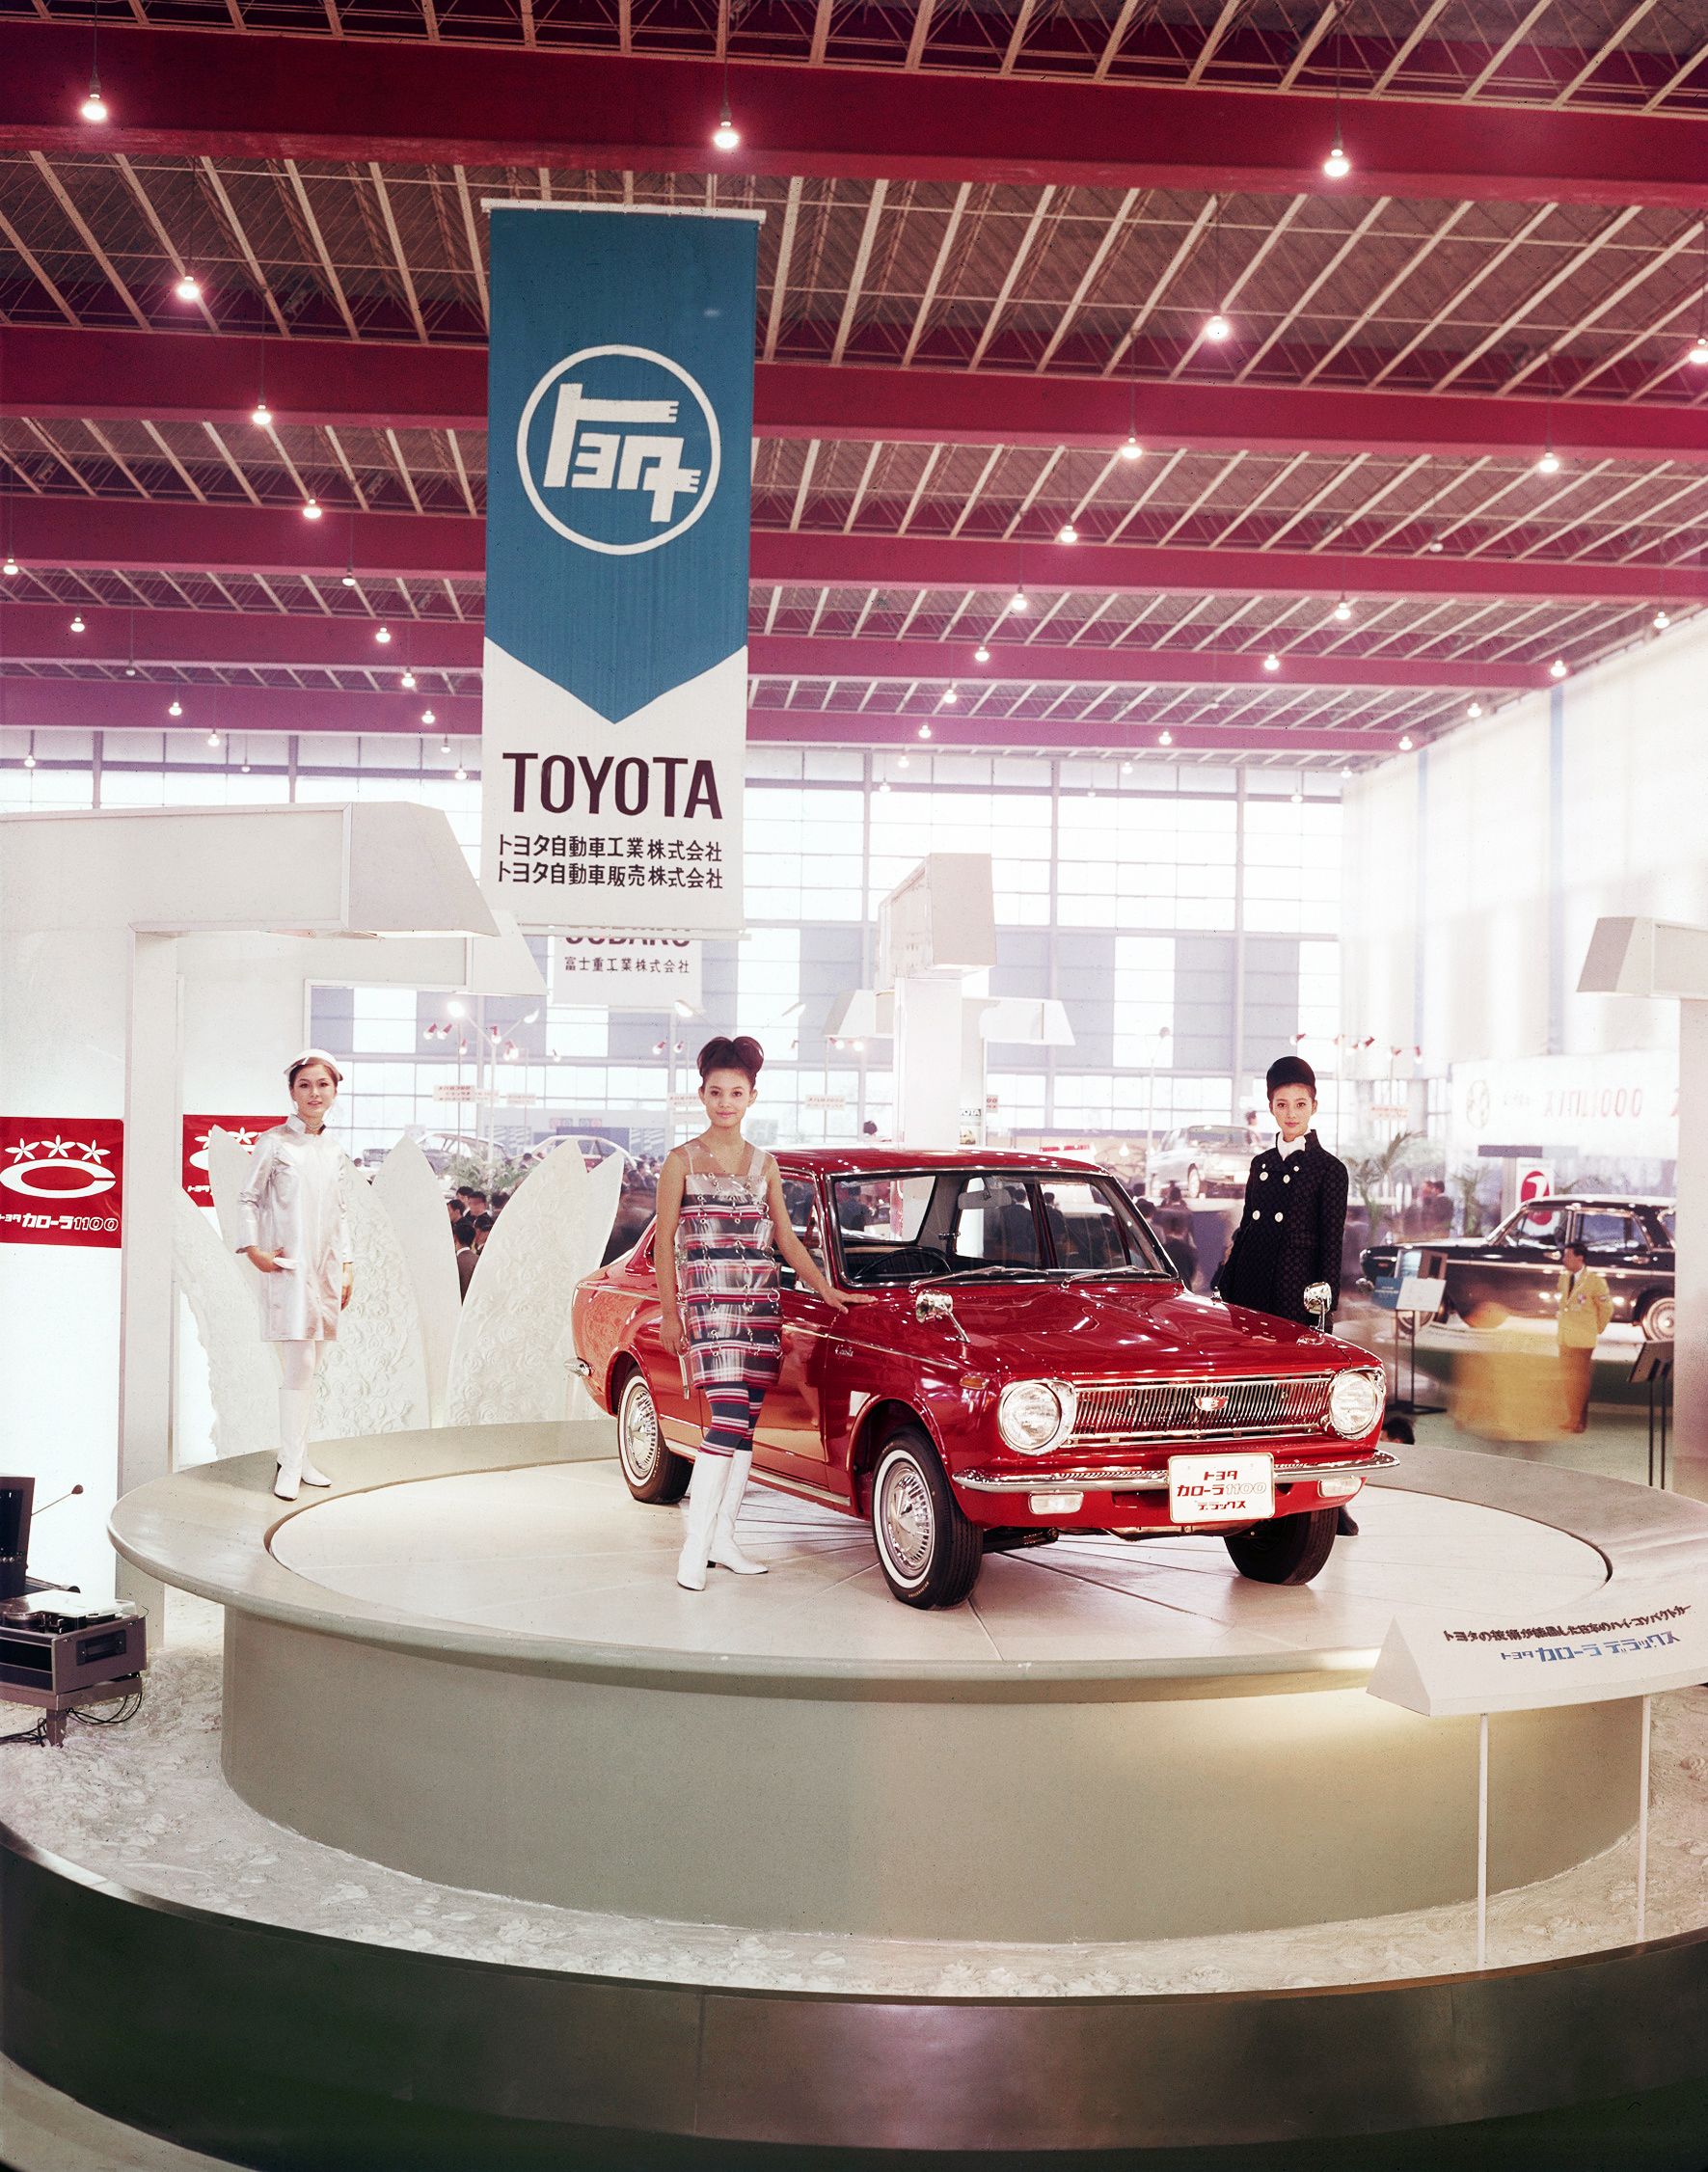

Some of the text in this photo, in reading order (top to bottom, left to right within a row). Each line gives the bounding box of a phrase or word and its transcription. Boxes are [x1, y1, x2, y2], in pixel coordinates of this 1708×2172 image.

[502, 752, 723, 820] TOYOTA
[499, 834, 722, 862] トヨタ自動車工業株式会社
[498, 860, 723, 889] トヨタ自動車販売株式会社
[565, 956, 691, 974] 富士重工業株式会社
[1204, 1471, 1237, 1481] トヨタ
[1198, 1501, 1246, 1511] デラックス
[1501, 1630, 1681, 1663] トヨタ カローラ デラックス
